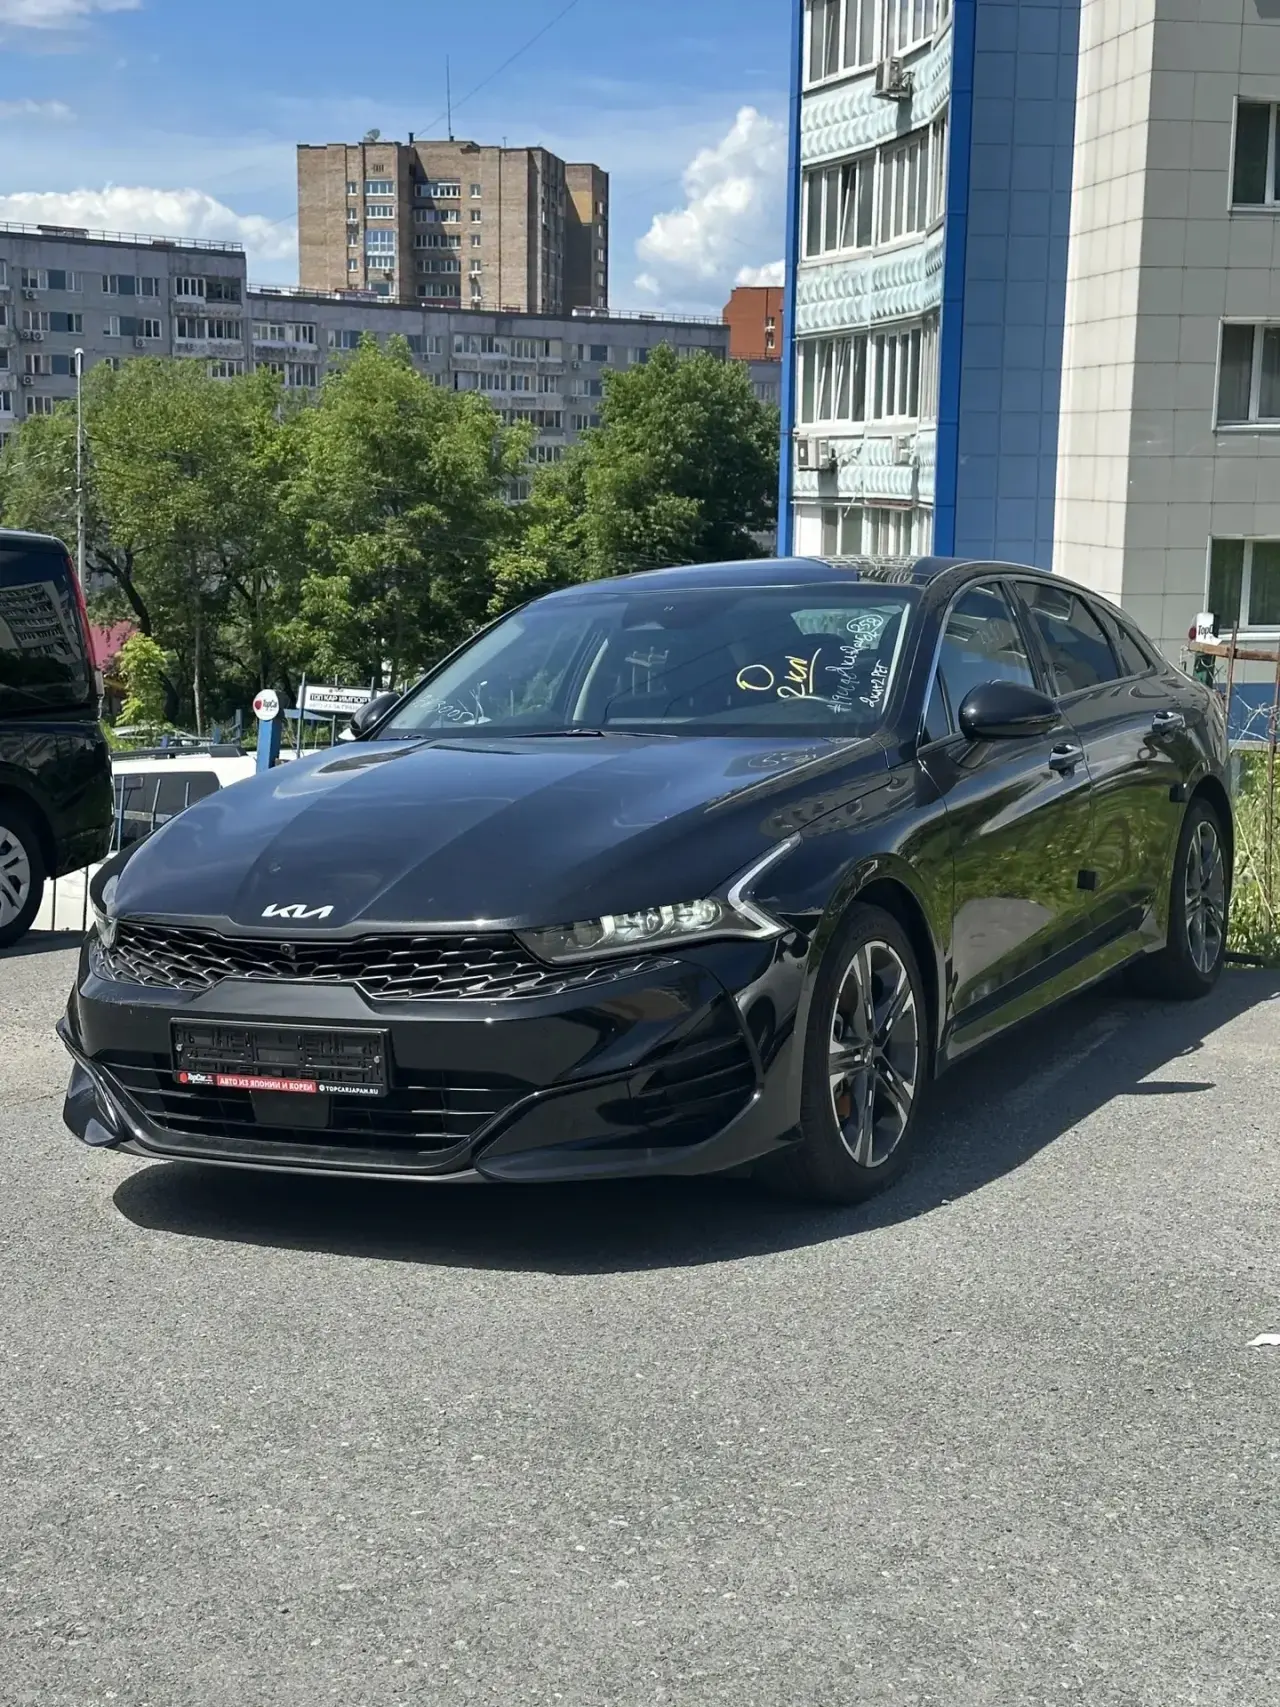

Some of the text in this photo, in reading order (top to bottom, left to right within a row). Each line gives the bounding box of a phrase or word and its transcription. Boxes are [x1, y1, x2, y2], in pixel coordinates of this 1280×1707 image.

[260, 903, 335, 920] KIA
[219, 1077, 237, 1086] АВТО
[238, 1078, 249, 1087] ИЗ
[249, 1079, 281, 1089] ЯПОНИИ
[281, 1081, 288, 1089] И
[288, 1082, 313, 1091] КОРЕИ
[325, 1084, 379, 1095] TOPCARJAPAN.RU
